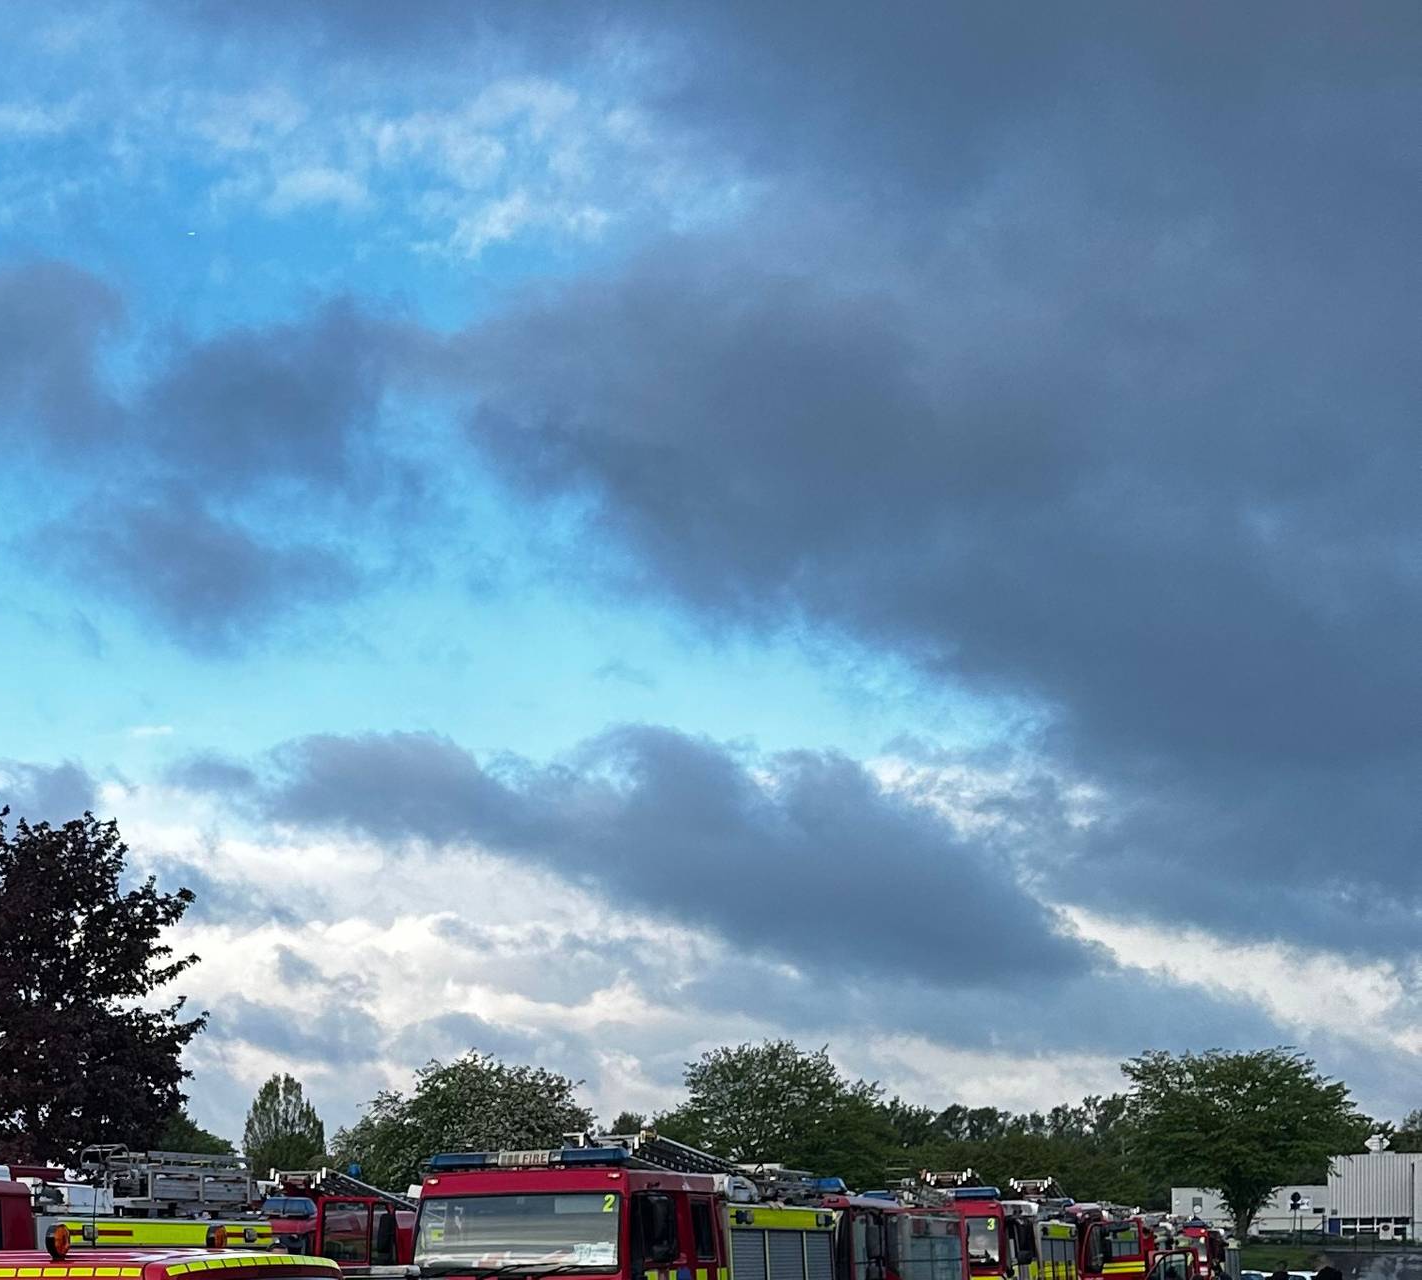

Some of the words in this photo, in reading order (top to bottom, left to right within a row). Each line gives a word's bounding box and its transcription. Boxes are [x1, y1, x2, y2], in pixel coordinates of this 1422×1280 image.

[521, 1152, 547, 1165] FIRE
[602, 1194, 616, 1213] 2
[986, 1217, 996, 1231] 3
